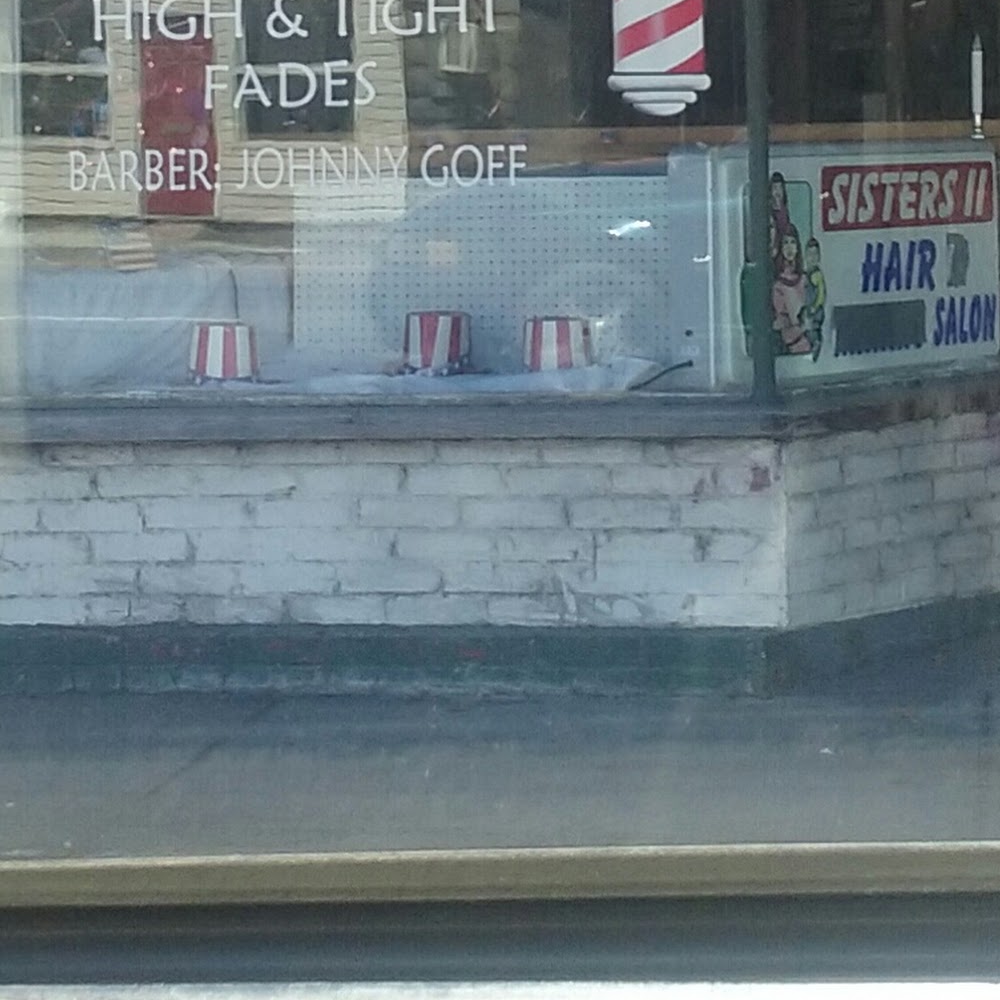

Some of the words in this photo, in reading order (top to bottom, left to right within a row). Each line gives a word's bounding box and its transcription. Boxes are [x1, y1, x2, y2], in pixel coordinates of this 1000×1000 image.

[204, 59, 377, 110] FADES
[69, 147, 221, 192] BARBER:
[235, 146, 408, 189] JOHNNY
[420, 144, 527, 187] GOFF
[827, 169, 958, 225] SISTERS
[860, 238, 938, 294] HAIR
[933, 293, 997, 347] SALON
